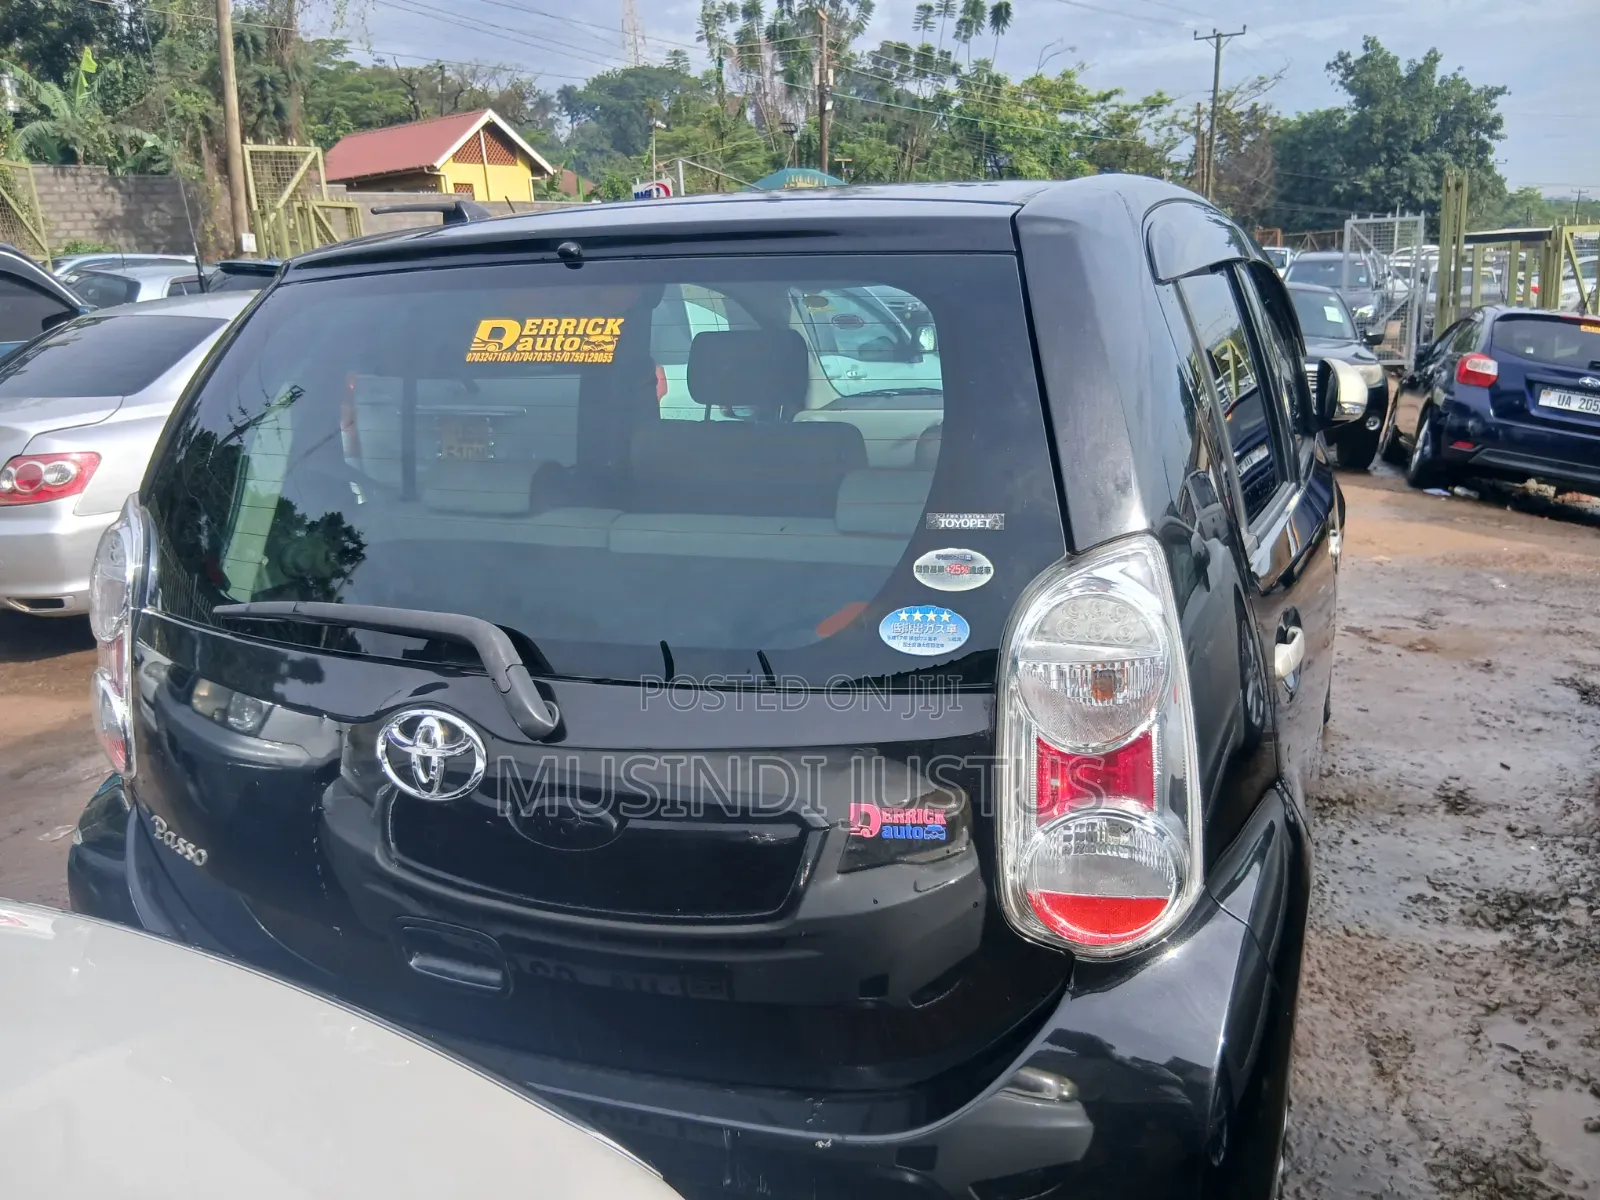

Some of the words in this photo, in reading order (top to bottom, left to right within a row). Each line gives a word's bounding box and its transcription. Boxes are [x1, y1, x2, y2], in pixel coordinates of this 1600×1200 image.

[469, 318, 625, 352] DERRICK
[516, 335, 581, 352] auto
[1557, 395, 1572, 408] UA
[1578, 398, 1600, 413] 205
[939, 518, 992, 528] TOYOPET
[891, 623, 958, 636] 低排出ガス車
[849, 803, 947, 838] DERRICK
[881, 824, 924, 839] auto
[150, 814, 208, 867] Passo
